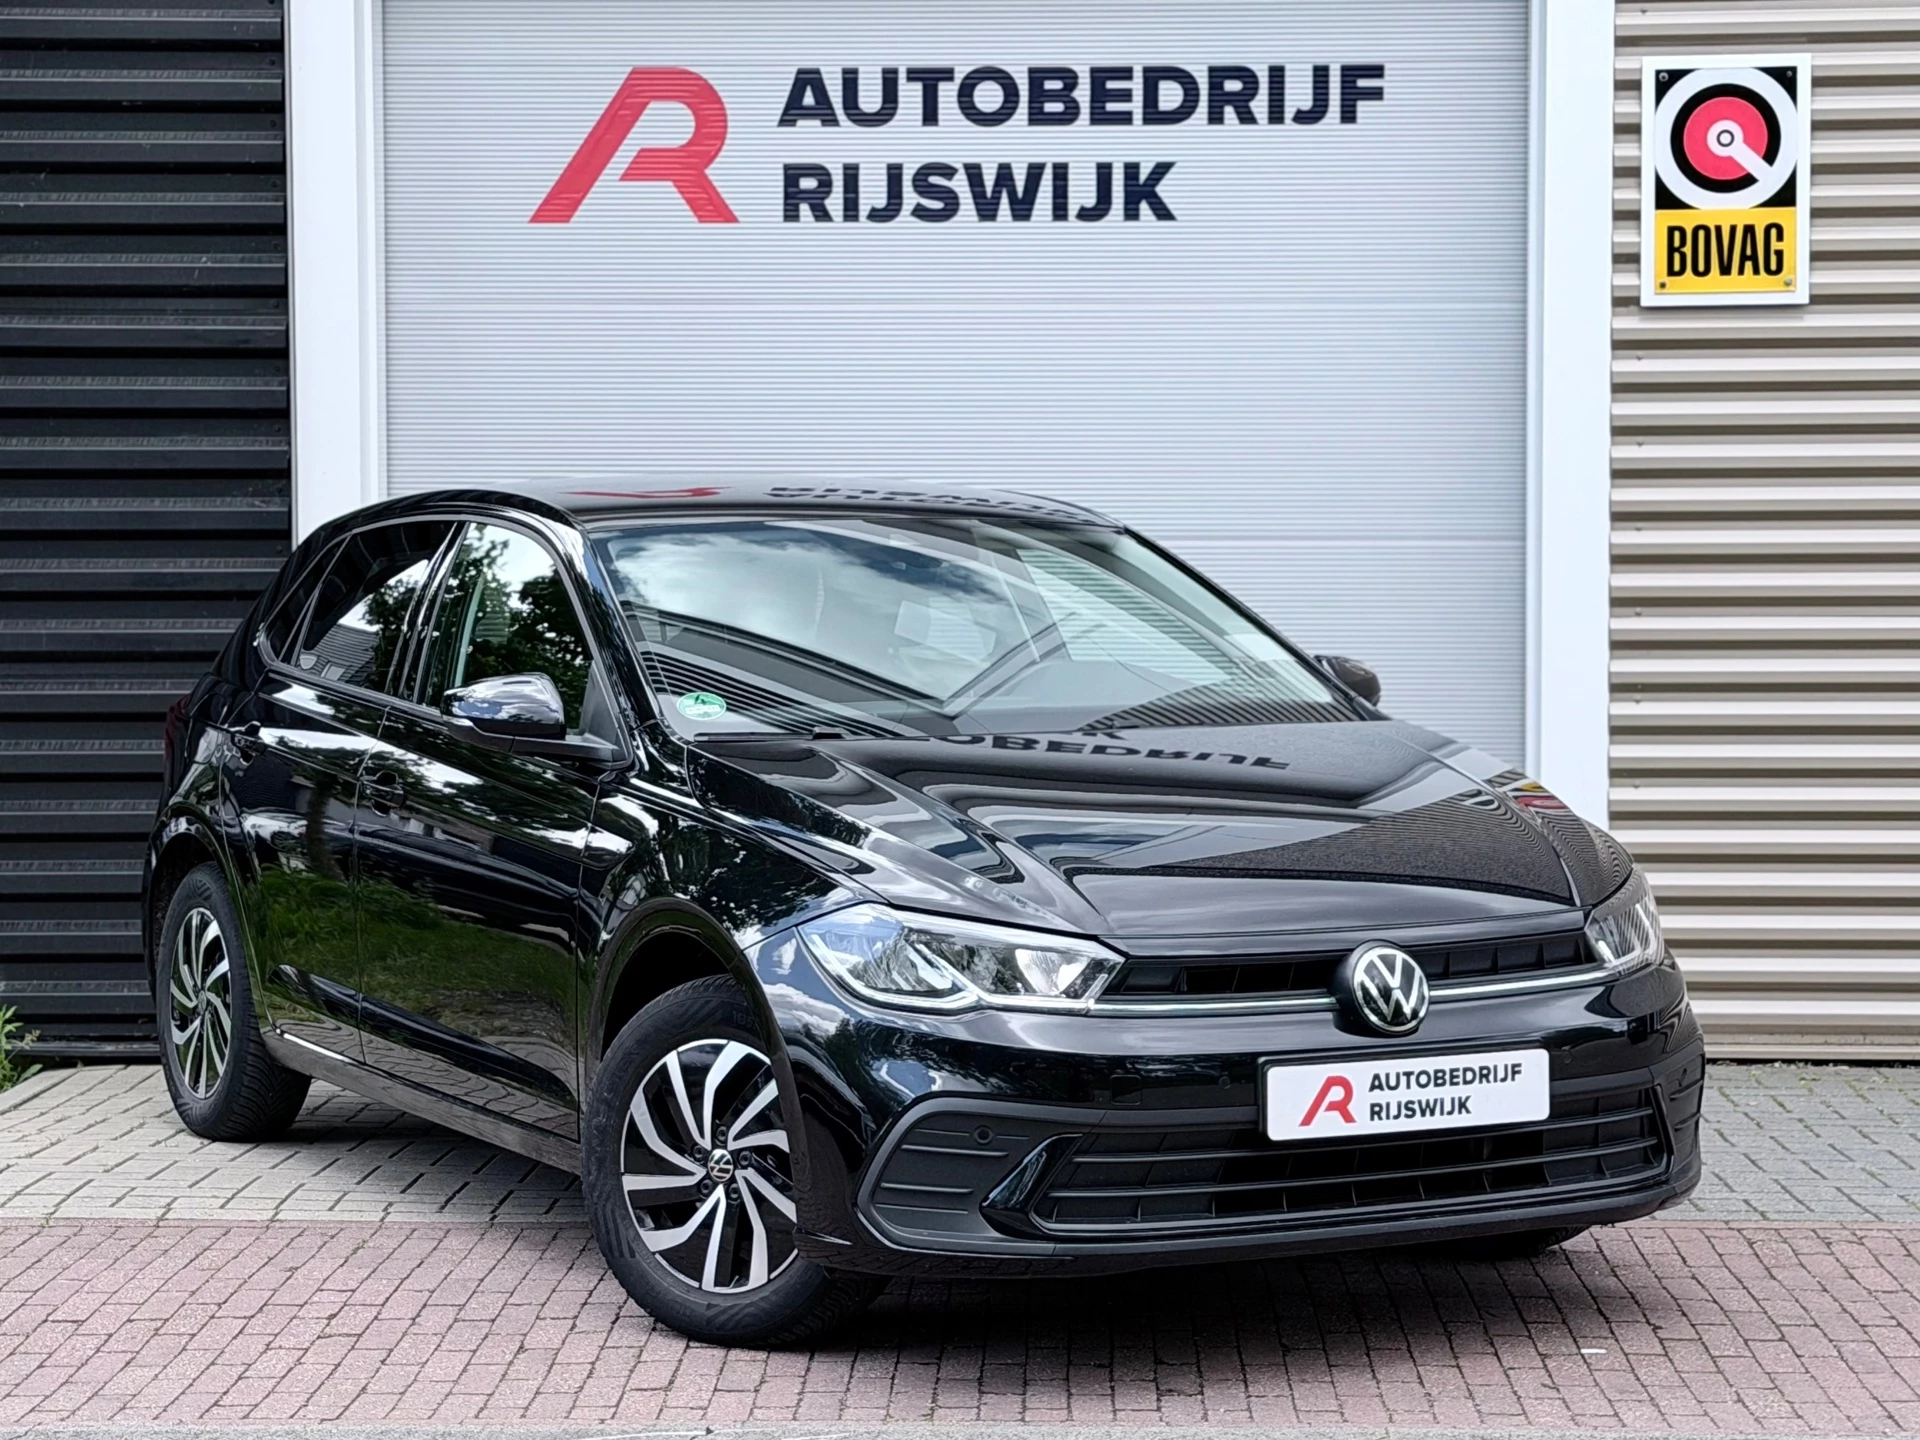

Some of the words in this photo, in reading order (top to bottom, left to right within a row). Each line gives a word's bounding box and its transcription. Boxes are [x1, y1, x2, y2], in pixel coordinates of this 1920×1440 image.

[777, 65, 1385, 128] AUTOBEDRIJF
[783, 161, 1177, 223] RIJSWIJK
[1666, 222, 1785, 278] BOVAG
[1368, 1062, 1523, 1093] AUTOBEDRIJF
[1369, 1095, 1473, 1122] RIJSWIJK
